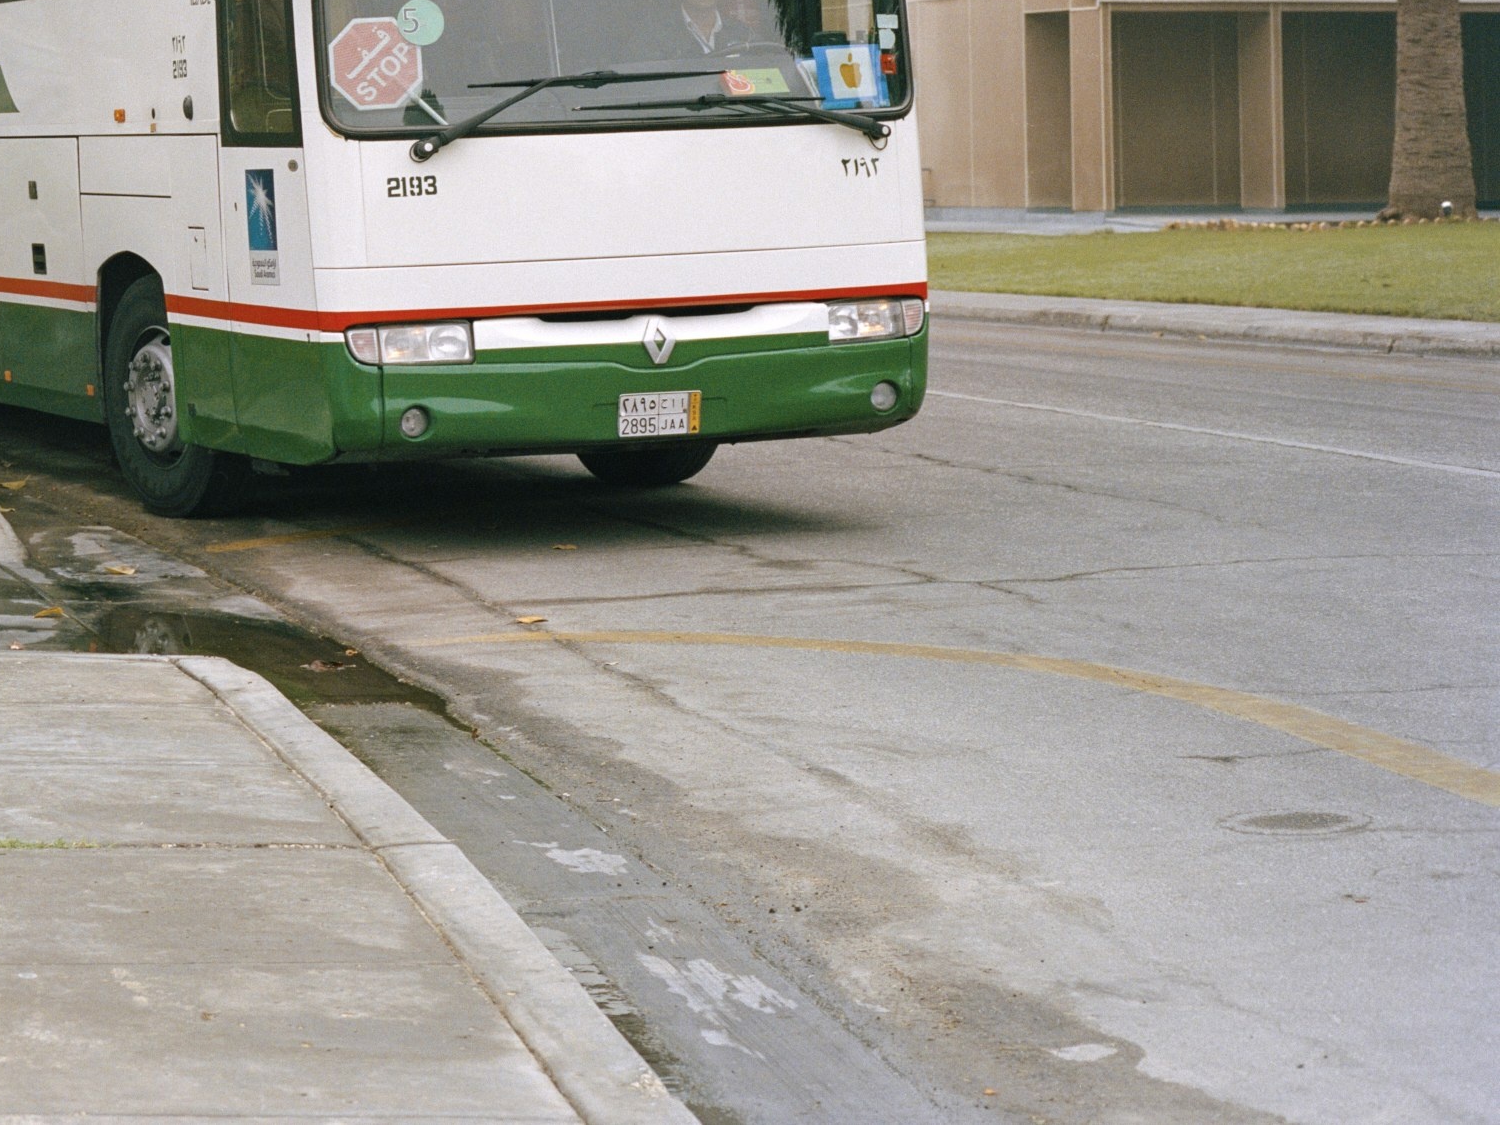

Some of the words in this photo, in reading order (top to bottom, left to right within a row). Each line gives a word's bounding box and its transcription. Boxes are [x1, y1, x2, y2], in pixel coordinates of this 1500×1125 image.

[403, 7, 419, 34] 5
[346, 26, 391, 80] قف
[173, 59, 188, 79] 2193
[356, 42, 410, 102] STOP
[386, 175, 438, 198] 2193
[622, 397, 657, 414] ٢٨٩٥
[621, 416, 657, 436] 2895
[661, 418, 685, 431] JAA
